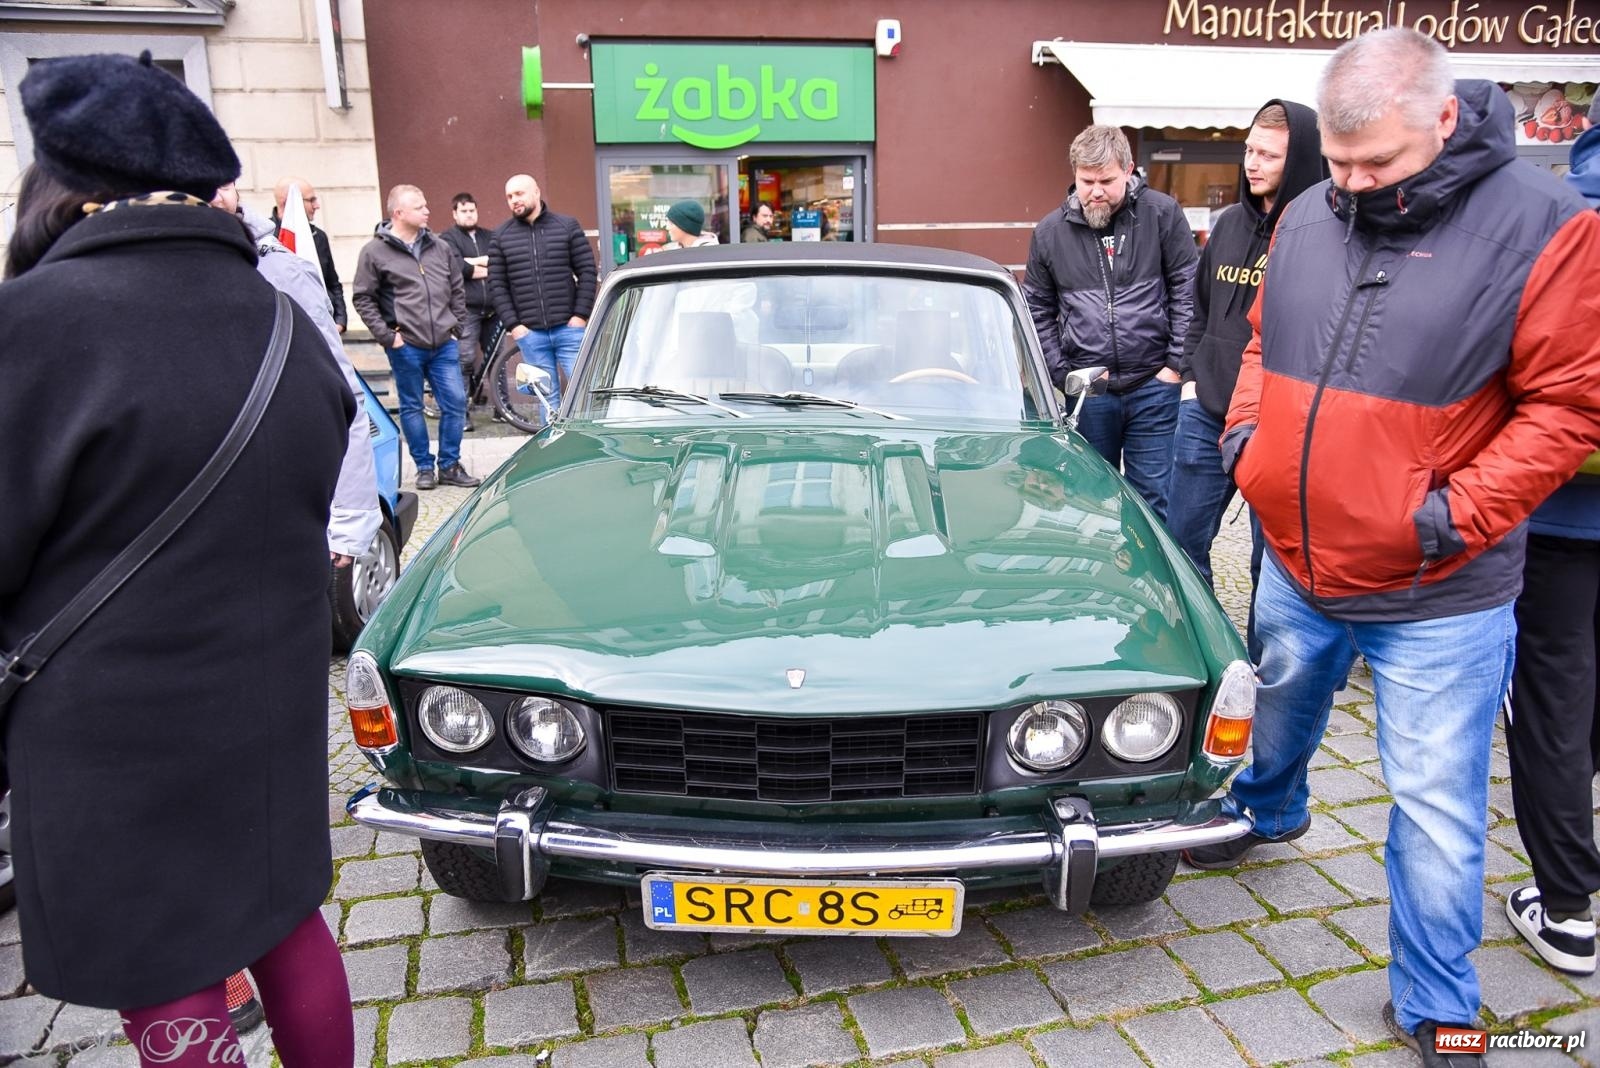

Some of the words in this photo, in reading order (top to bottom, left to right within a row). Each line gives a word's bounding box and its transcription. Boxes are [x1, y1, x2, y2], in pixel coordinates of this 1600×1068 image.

[1163, 0, 1384, 43] Manufaktura
[635, 62, 839, 121] żabka
[1216, 264, 1265, 287] KUBO
[654, 906, 672, 918] PL
[685, 886, 794, 924] SRC
[817, 890, 880, 926] 8S
